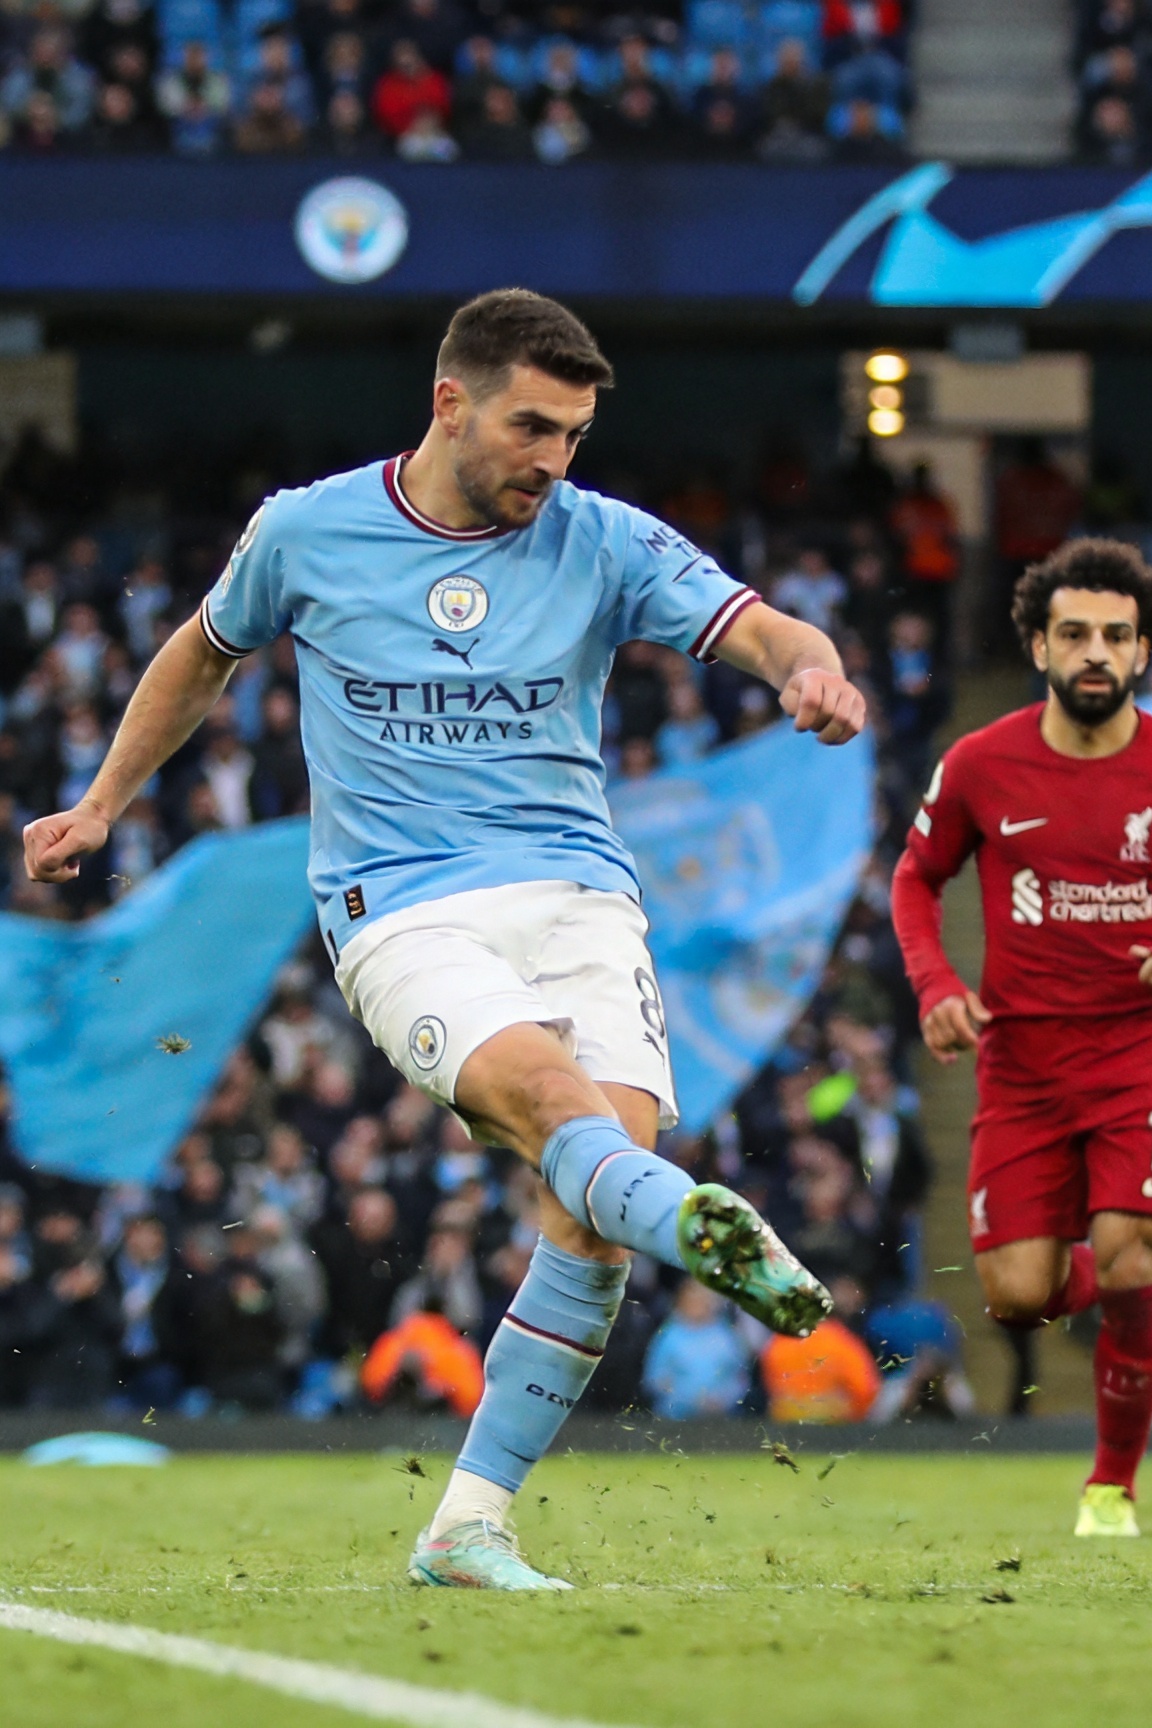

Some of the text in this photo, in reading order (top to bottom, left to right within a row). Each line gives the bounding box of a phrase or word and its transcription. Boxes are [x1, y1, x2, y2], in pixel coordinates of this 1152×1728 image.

[344, 676, 564, 713] ETIHAD
[379, 721, 532, 745] AIRWAYS
[1048, 877, 1148, 902] standard
